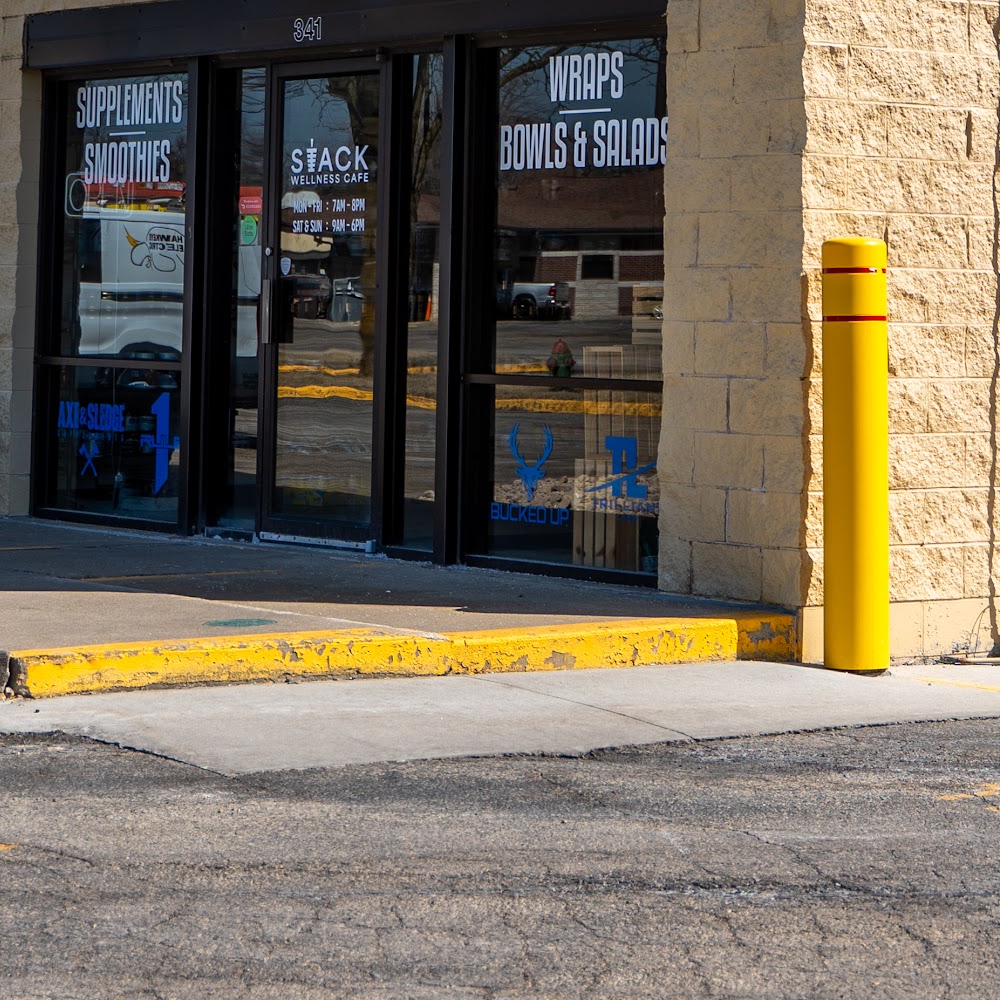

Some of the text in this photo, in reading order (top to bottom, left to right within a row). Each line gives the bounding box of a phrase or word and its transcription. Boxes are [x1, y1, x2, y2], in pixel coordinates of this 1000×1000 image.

[293, 16, 322, 42] 341
[550, 51, 624, 102] WRAPS
[76, 80, 183, 129] SUPPLEMENTS
[290, 138, 370, 173] STACK
[500, 116, 669, 171] BOWLS & SALADS
[84, 139, 171, 185] SMOOTHIES
[290, 172, 369, 185] WELLNESS CAFE
[293, 200, 307, 213] MON
[312, 200, 323, 212] FRI
[292, 220, 303, 233] SAT
[310, 220, 323, 232] SUN
[490, 502, 570, 526] BUCKED UP
